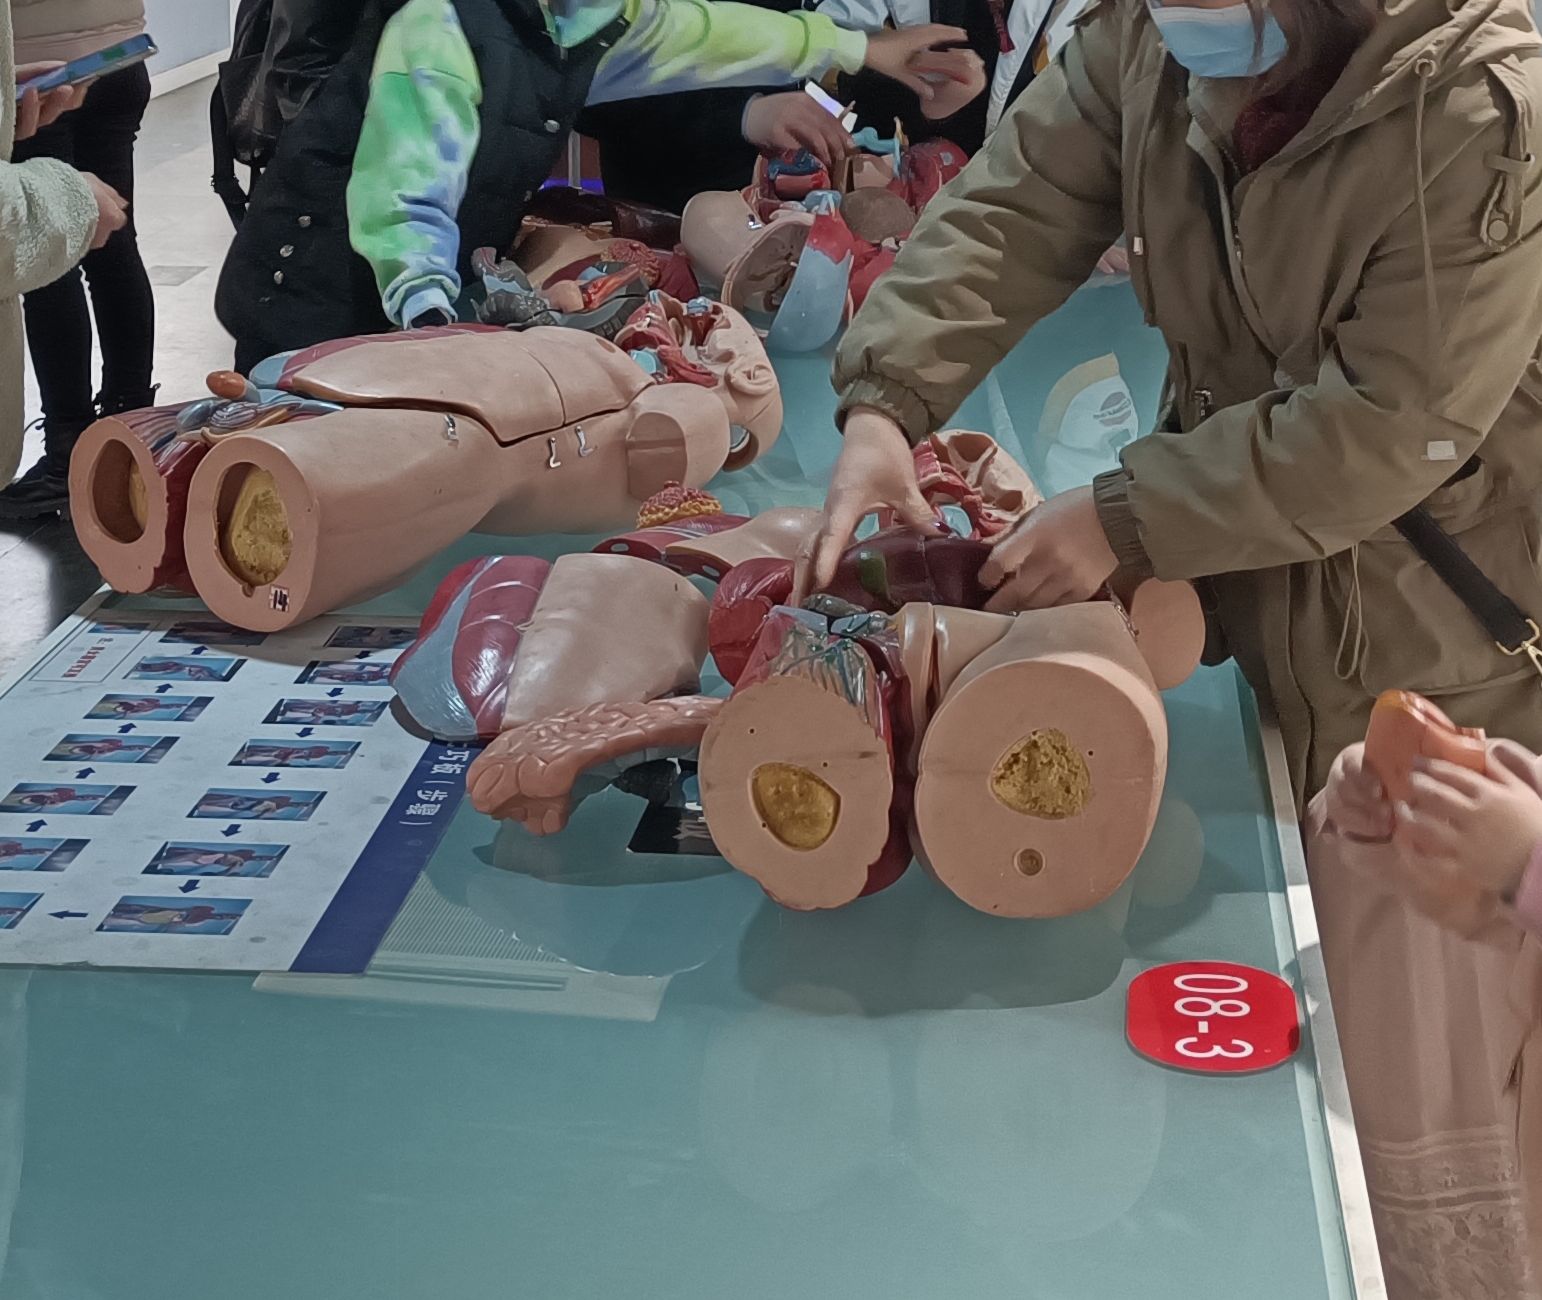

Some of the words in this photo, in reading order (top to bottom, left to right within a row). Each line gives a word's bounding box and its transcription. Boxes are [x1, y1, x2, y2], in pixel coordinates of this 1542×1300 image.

[273, 589, 288, 612] 14
[399, 742, 470, 826] 巧板（步骤）
[1174, 973, 1254, 1058] 08-3
